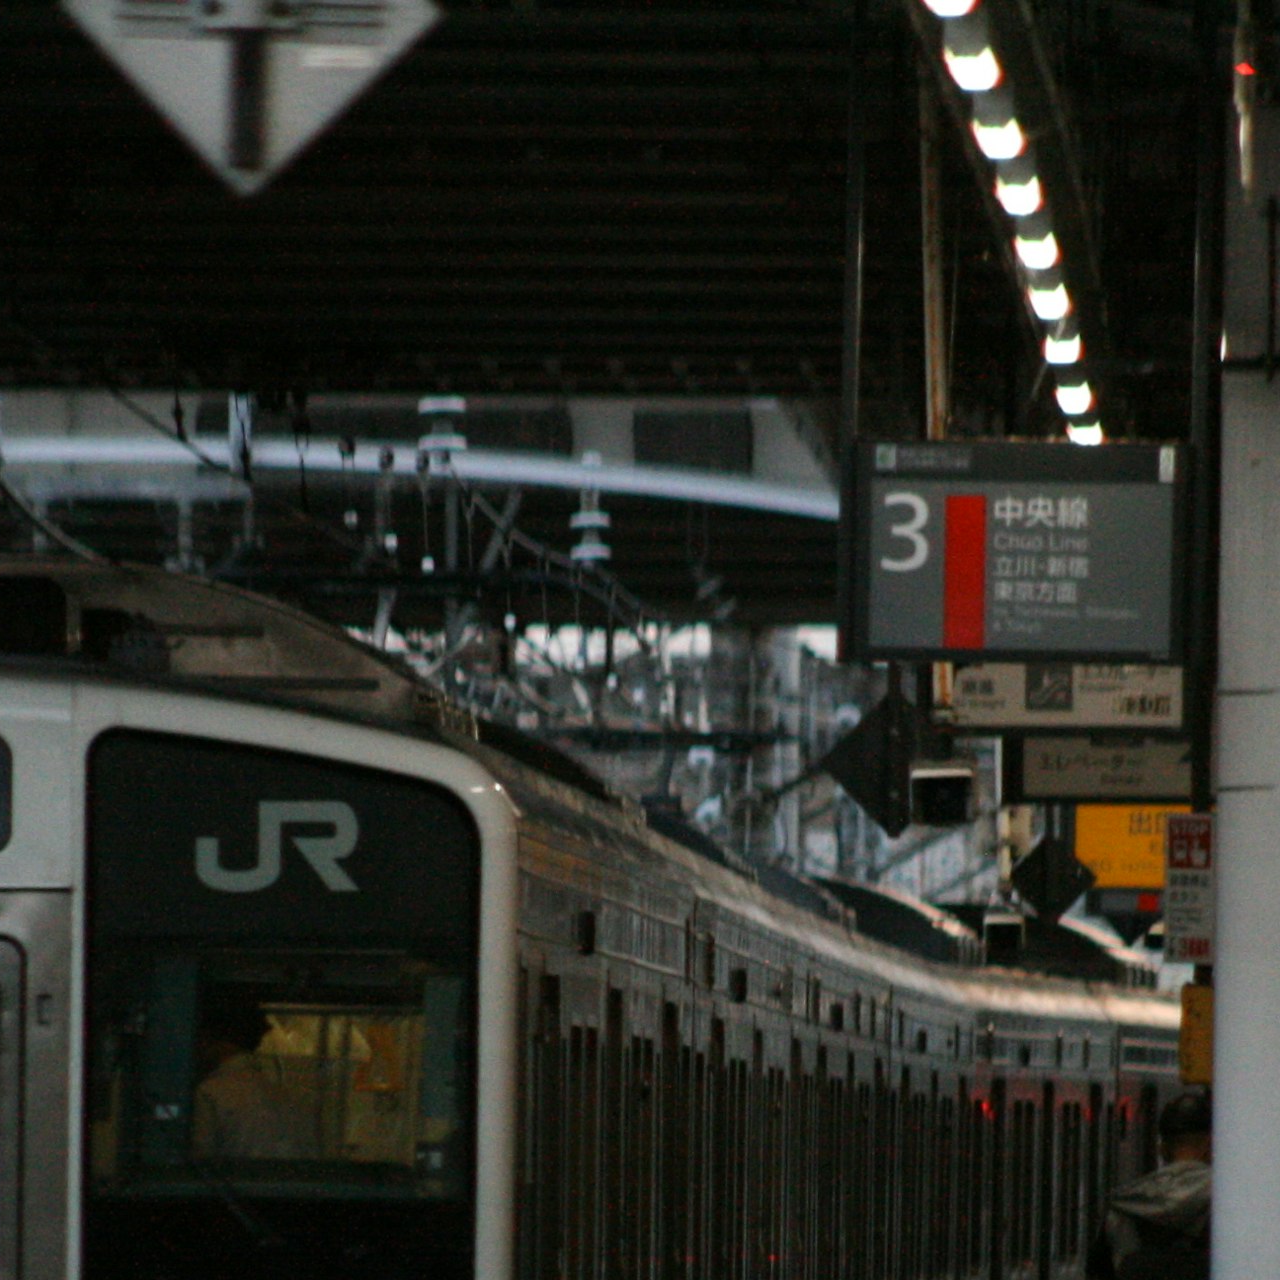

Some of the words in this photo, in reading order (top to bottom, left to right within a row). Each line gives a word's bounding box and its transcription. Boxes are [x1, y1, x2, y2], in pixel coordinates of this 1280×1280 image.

[879, 492, 930, 573] 3
[993, 494, 1089, 529] 中央線
[195, 799, 361, 894] JR
